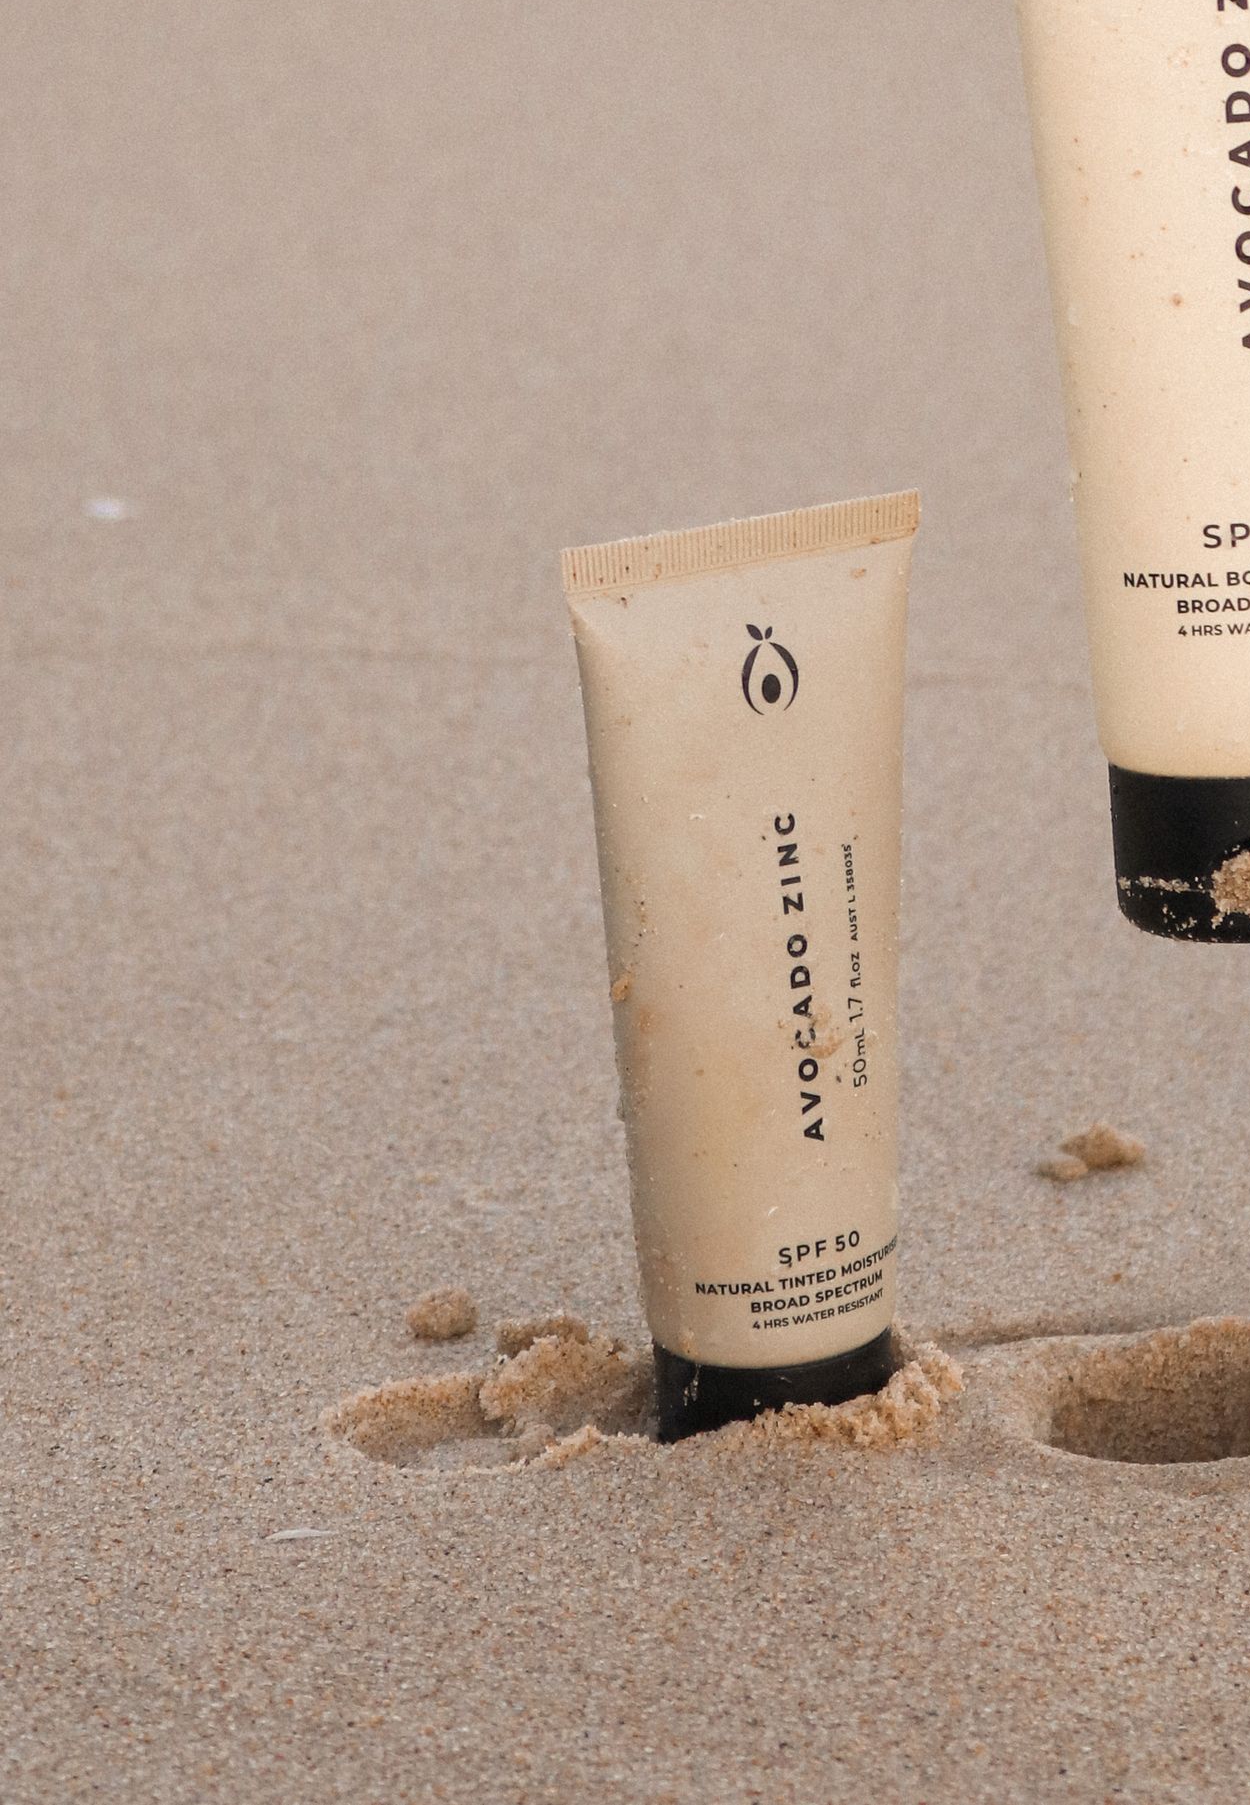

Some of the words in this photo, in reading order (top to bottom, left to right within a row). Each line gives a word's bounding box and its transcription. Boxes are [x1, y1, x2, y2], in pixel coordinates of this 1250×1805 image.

[1123, 572, 1219, 589] NATURAL
[1177, 625, 1188, 637] 4
[1191, 624, 1223, 637] HRS
[773, 812, 804, 916] ZINC
[847, 894, 856, 904] L
[848, 907, 859, 942] AUST
[849, 951, 862, 989] fl.oz
[847, 997, 864, 1023] 1.7
[786, 933, 825, 1142] AVOCADO
[852, 1027, 868, 1088] 50mL
[778, 1239, 827, 1266] SPF
[835, 1230, 860, 1253] 50
[695, 1280, 775, 1296] NATURAL
[778, 1268, 837, 1291] TINTED
[750, 1294, 811, 1314] BROAD
[815, 1268, 884, 1304] SPECTRUM
[752, 1320, 761, 1330] 4
[763, 1317, 790, 1330] HRS
[791, 1307, 835, 1325] WATER
[837, 1287, 884, 1314] RESISTANT
